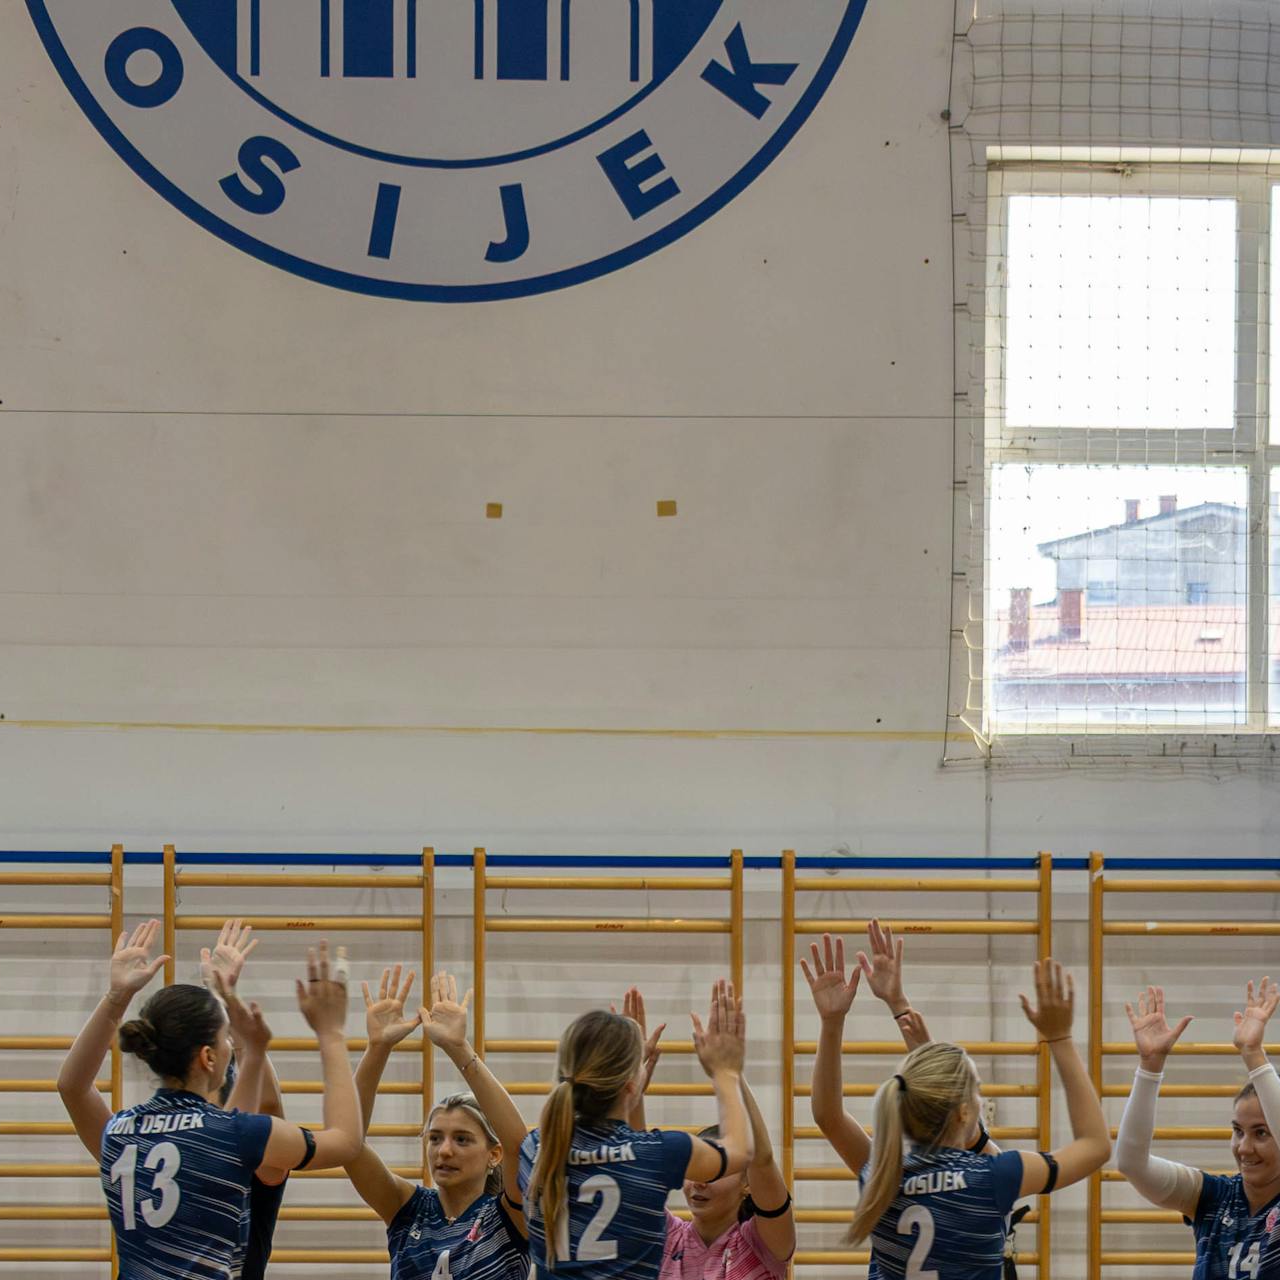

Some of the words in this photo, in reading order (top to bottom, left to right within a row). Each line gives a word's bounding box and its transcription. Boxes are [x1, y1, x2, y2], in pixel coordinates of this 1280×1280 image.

[104, 22, 799, 263] OSIJEK
[140, 1113, 206, 1134] OSIJEK
[111, 1142, 181, 1230] 13
[904, 1171, 968, 1195] OSIJEK
[1227, 1241, 1261, 1279] 14
